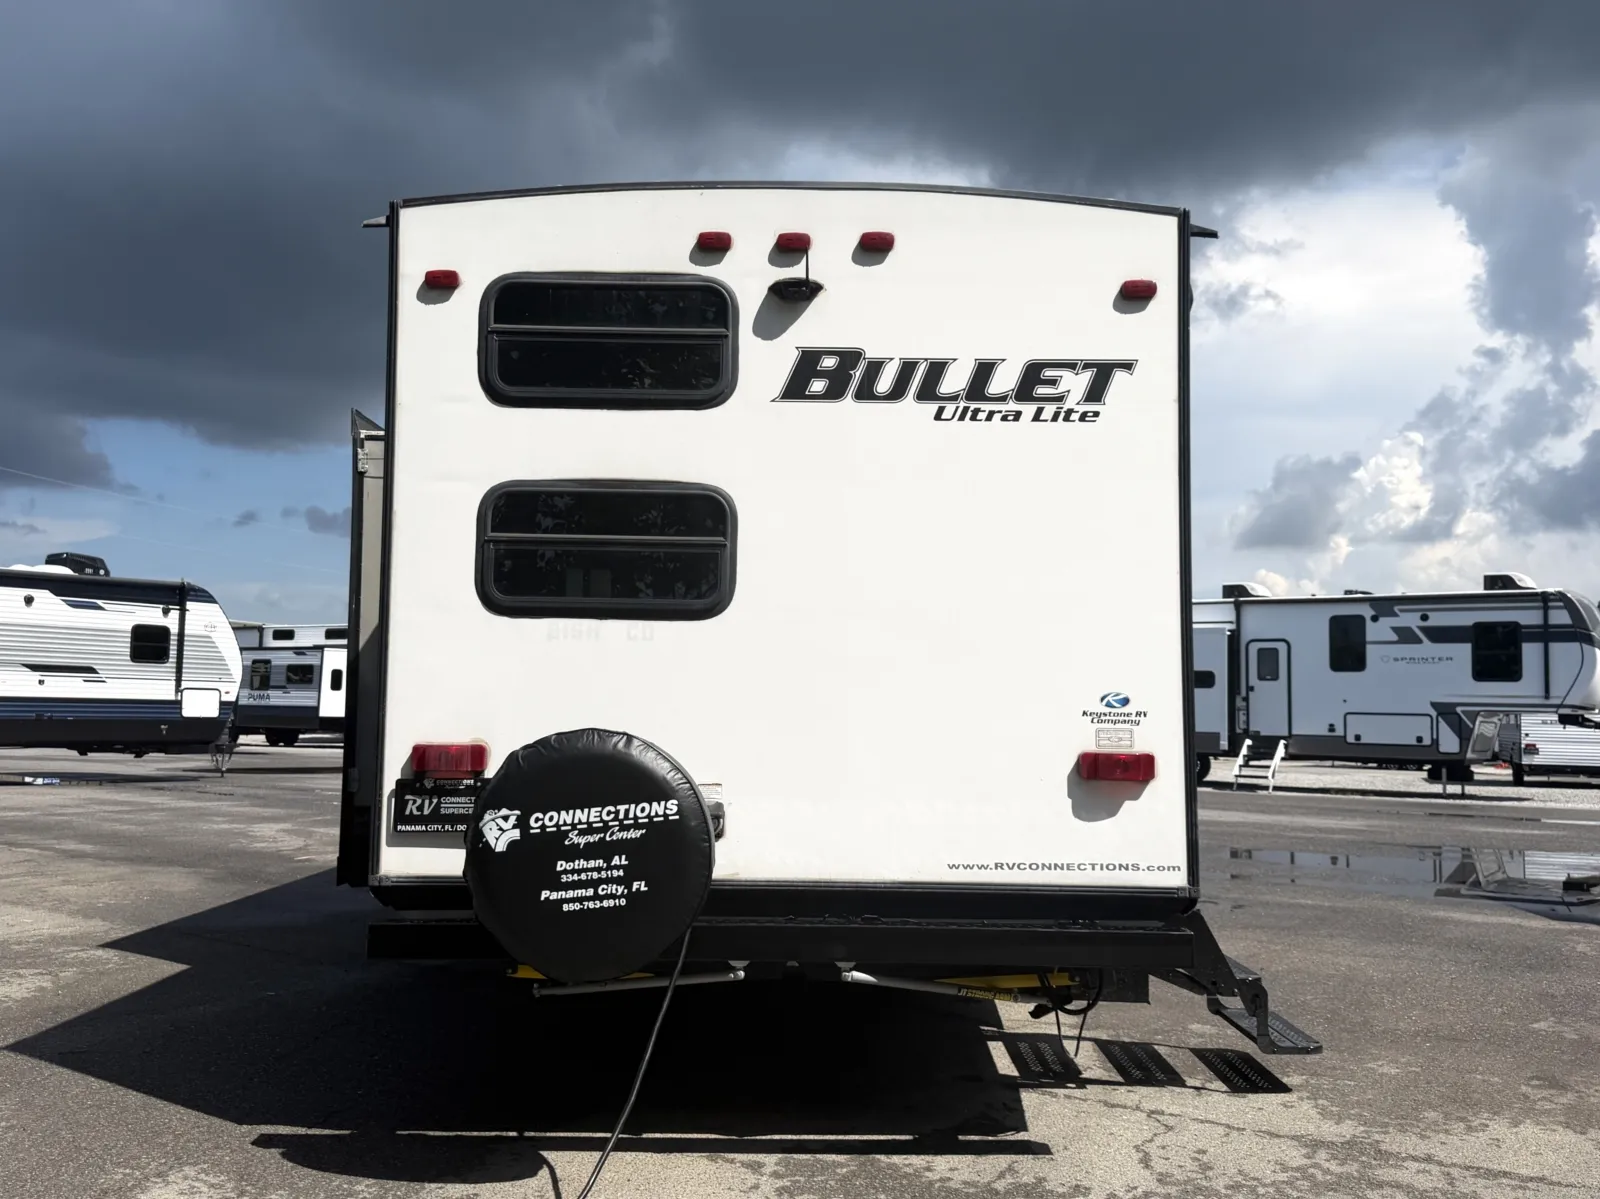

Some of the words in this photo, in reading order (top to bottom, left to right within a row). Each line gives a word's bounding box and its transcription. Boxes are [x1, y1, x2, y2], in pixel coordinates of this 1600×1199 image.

[770, 346, 1139, 405] BULLET
[933, 405, 1020, 422] Ultra
[1030, 407, 1100, 423] Lite
[247, 692, 270, 701] PUMA
[1081, 710, 1133, 718] Keystone
[1135, 710, 1148, 718] RV
[1090, 717, 1141, 726] Company
[404, 794, 438, 815] RV
[529, 799, 679, 827] CONNECTIONS
[397, 824, 426, 832] PANAMA
[427, 824, 444, 832] CITY,
[565, 830, 604, 849] Super
[606, 826, 646, 842] Center
[556, 858, 607, 871] Dothan,
[611, 854, 629, 866] AL
[947, 862, 1182, 872] www.RVCONNECTIONS.com
[560, 869, 624, 882] 334-678-5194
[540, 888, 594, 901] Panama
[598, 884, 628, 896] City,
[632, 881, 648, 892] FL
[562, 898, 626, 912] 850-763-6910
